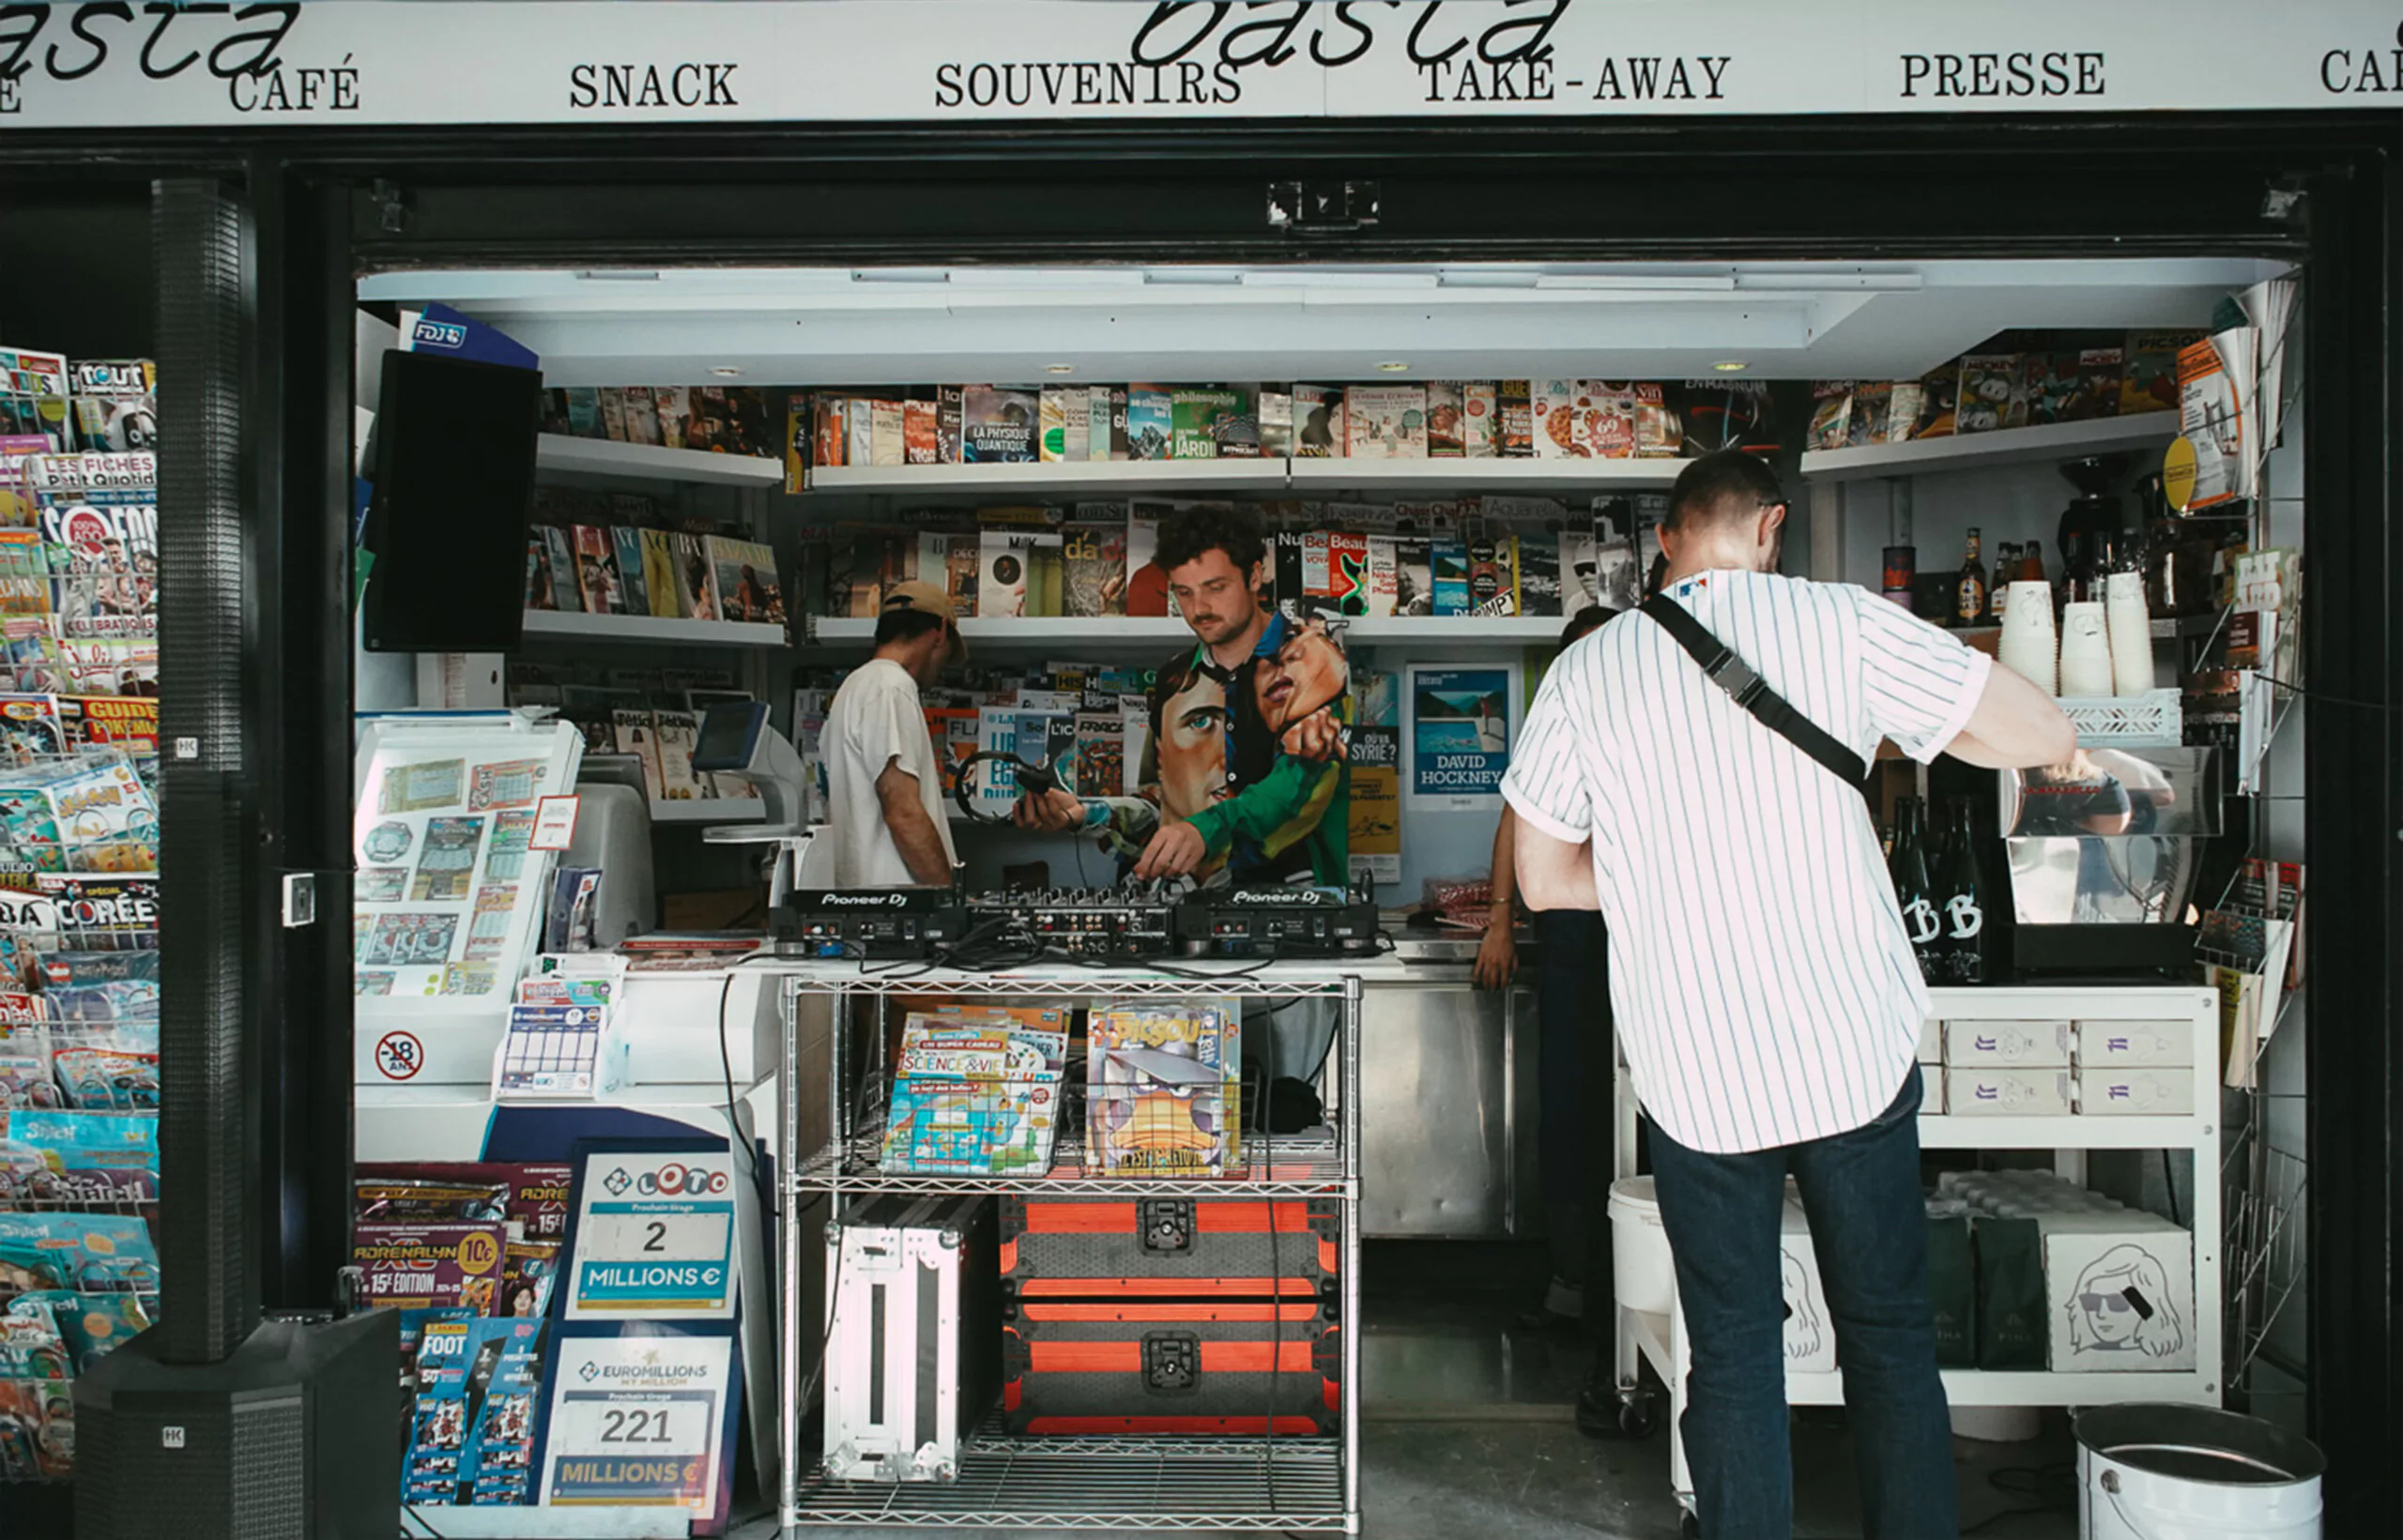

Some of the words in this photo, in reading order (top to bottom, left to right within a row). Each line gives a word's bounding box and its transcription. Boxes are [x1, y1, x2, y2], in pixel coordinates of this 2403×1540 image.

[0, 3, 300, 80] asta
[229, 54, 360, 112] CAFÉ
[569, 64, 738, 108] SNACK
[935, 62, 1242, 107] SOUVENIRS
[1418, 56, 1731, 102] TAKE-AWAY
[1901, 53, 2105, 98] PRESSE
[416, 324, 446, 342] FDJ
[973, 427, 985, 438] LA
[987, 427, 1031, 439] PHYSIQUE
[1596, 419, 1619, 434] 69
[976, 439, 1027, 452] QUANTIQUE
[85, 458, 154, 472] FICHES
[93, 473, 155, 486] Quotid
[89, 702, 158, 719] GUIDE
[950, 721, 979, 736] FLA
[1351, 744, 1386, 761] SYRIE
[1437, 755, 1486, 769] DAVID
[1421, 770, 1502, 785] HOCKNEY
[821, 893, 886, 906] Pioneer
[1232, 892, 1297, 905] Pioneer
[55, 892, 158, 925] CORÉE
[636, 1163, 728, 1196] LOTO
[520, 1187, 569, 1200] ADRE
[632, 1203, 668, 1212] Prochain
[670, 1204, 694, 1213] tirage
[643, 1221, 667, 1252] 2
[354, 1246, 457, 1259] ADRENALYN
[466, 1239, 494, 1263] 10€
[394, 1271, 436, 1294] ÉDITION
[589, 1268, 697, 1287] MILLIONS
[422, 1335, 467, 1355] FOOT
[603, 1365, 708, 1379] EUROMILLIONS
[608, 1392, 645, 1401] Prochain
[601, 1410, 672, 1443] 221
[561, 1462, 679, 1483] MILLIONS
